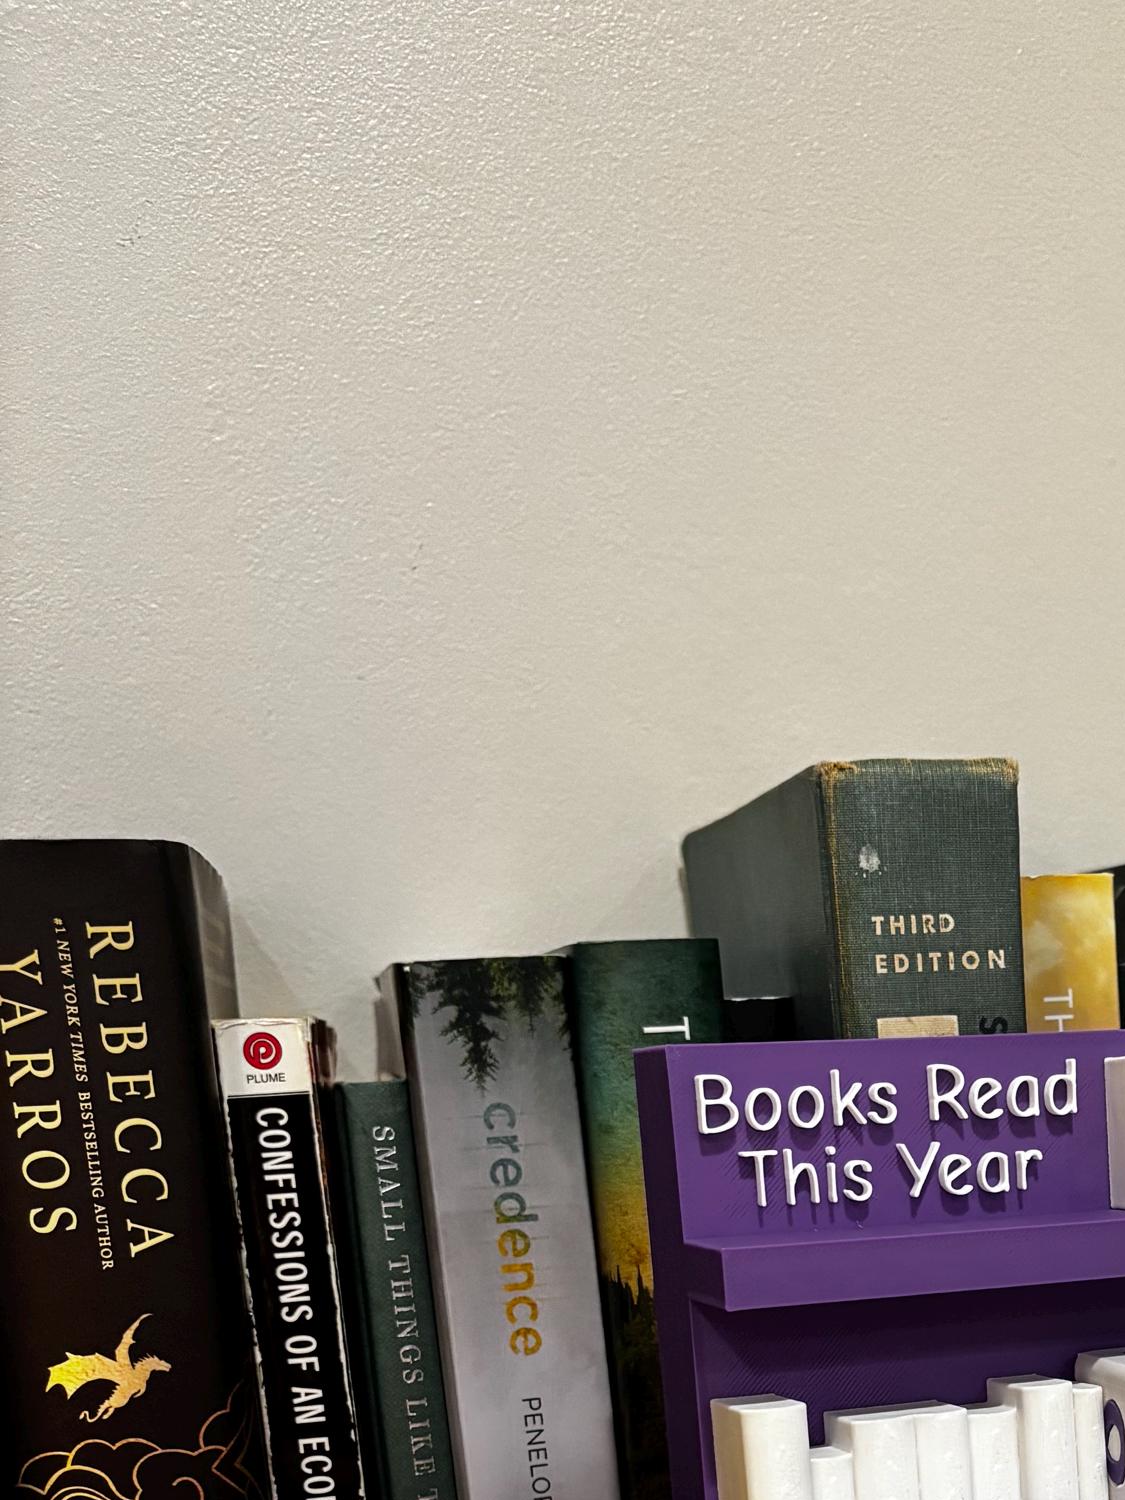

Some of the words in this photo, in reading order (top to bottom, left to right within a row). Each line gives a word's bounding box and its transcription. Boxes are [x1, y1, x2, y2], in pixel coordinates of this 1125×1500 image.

[53, 917, 66, 934] #1
[871, 914, 955, 936] THIRD
[56, 940, 74, 978] NEW
[875, 949, 1006, 975] EDITION
[63, 983, 81, 1027] YORK
[70, 1032, 88, 1083] TIMES
[85, 920, 175, 1257] REBECCA
[246, 1071, 286, 1085] PLUME
[0, 949, 77, 1234] YARROS
[694, 1069, 898, 1134] Books
[926, 1058, 1078, 1122] Read
[78, 1092, 104, 1198] BESTSELLING
[738, 1145, 873, 1207] This
[896, 1141, 1043, 1198] Year
[255, 1107, 313, 1323] CONFESSIONS
[372, 1125, 406, 1242] SMALL
[94, 1203, 114, 1270] AUTHOR
[483, 1102, 541, 1356] credence
[387, 1254, 424, 1384] THINGS
[285, 1339, 320, 1374] OF
[291, 1386, 326, 1424] AN
[405, 1399, 436, 1476] LIKE
